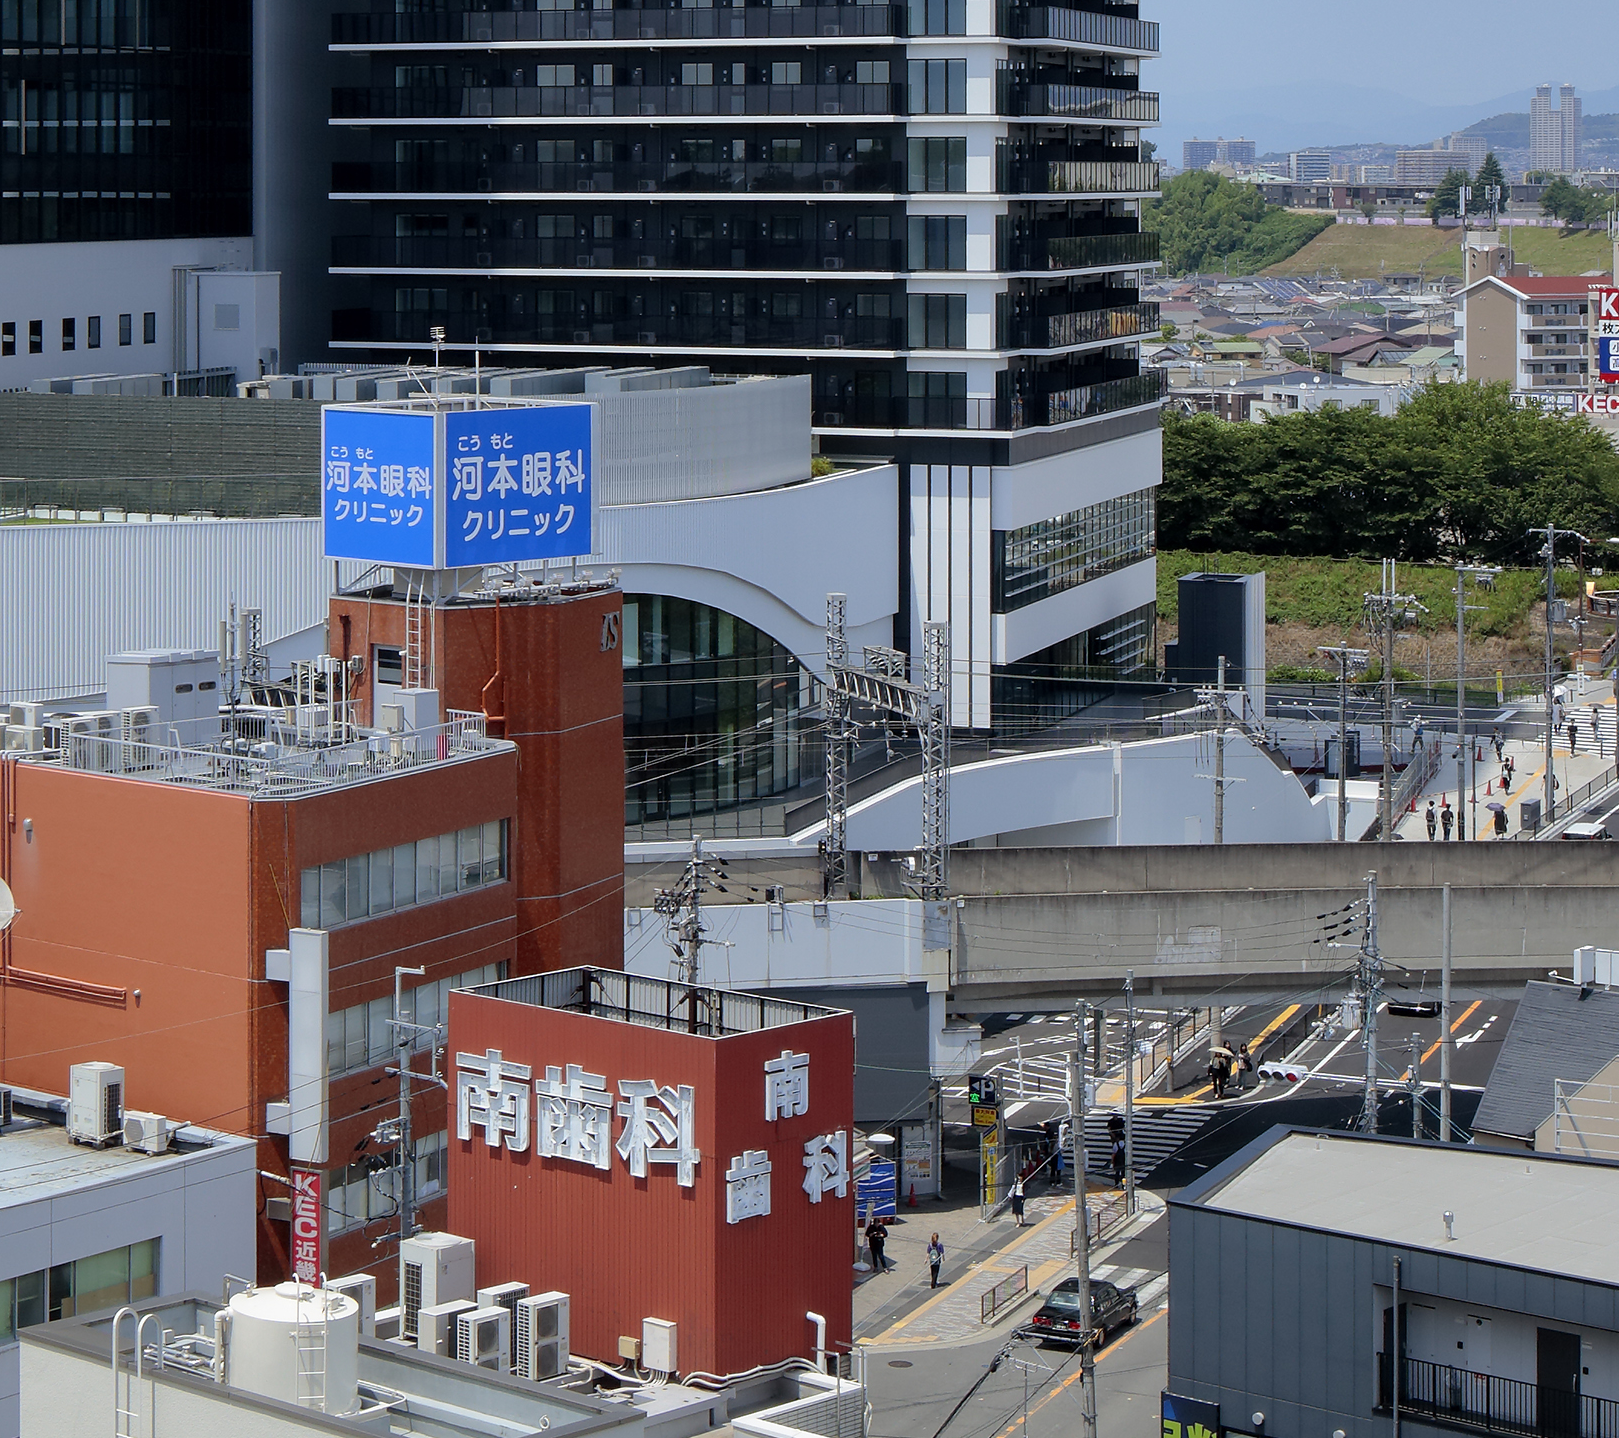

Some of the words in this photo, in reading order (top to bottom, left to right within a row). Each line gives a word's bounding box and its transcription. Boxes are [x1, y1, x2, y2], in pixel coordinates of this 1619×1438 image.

[331, 446, 349, 459] こう
[356, 448, 373, 460] もと
[457, 434, 481, 452] こう
[490, 432, 513, 450] もと
[326, 460, 432, 500] 河本眼科
[452, 447, 586, 502] 河本眼科
[334, 499, 424, 527] クリニック
[462, 503, 576, 542] クリニック
[765, 1050, 809, 1122] 南
[981, 1078, 994, 1099] P
[456, 1049, 700, 1187] 南歯科
[726, 1150, 772, 1224] 歯
[803, 1130, 849, 1204] 科
